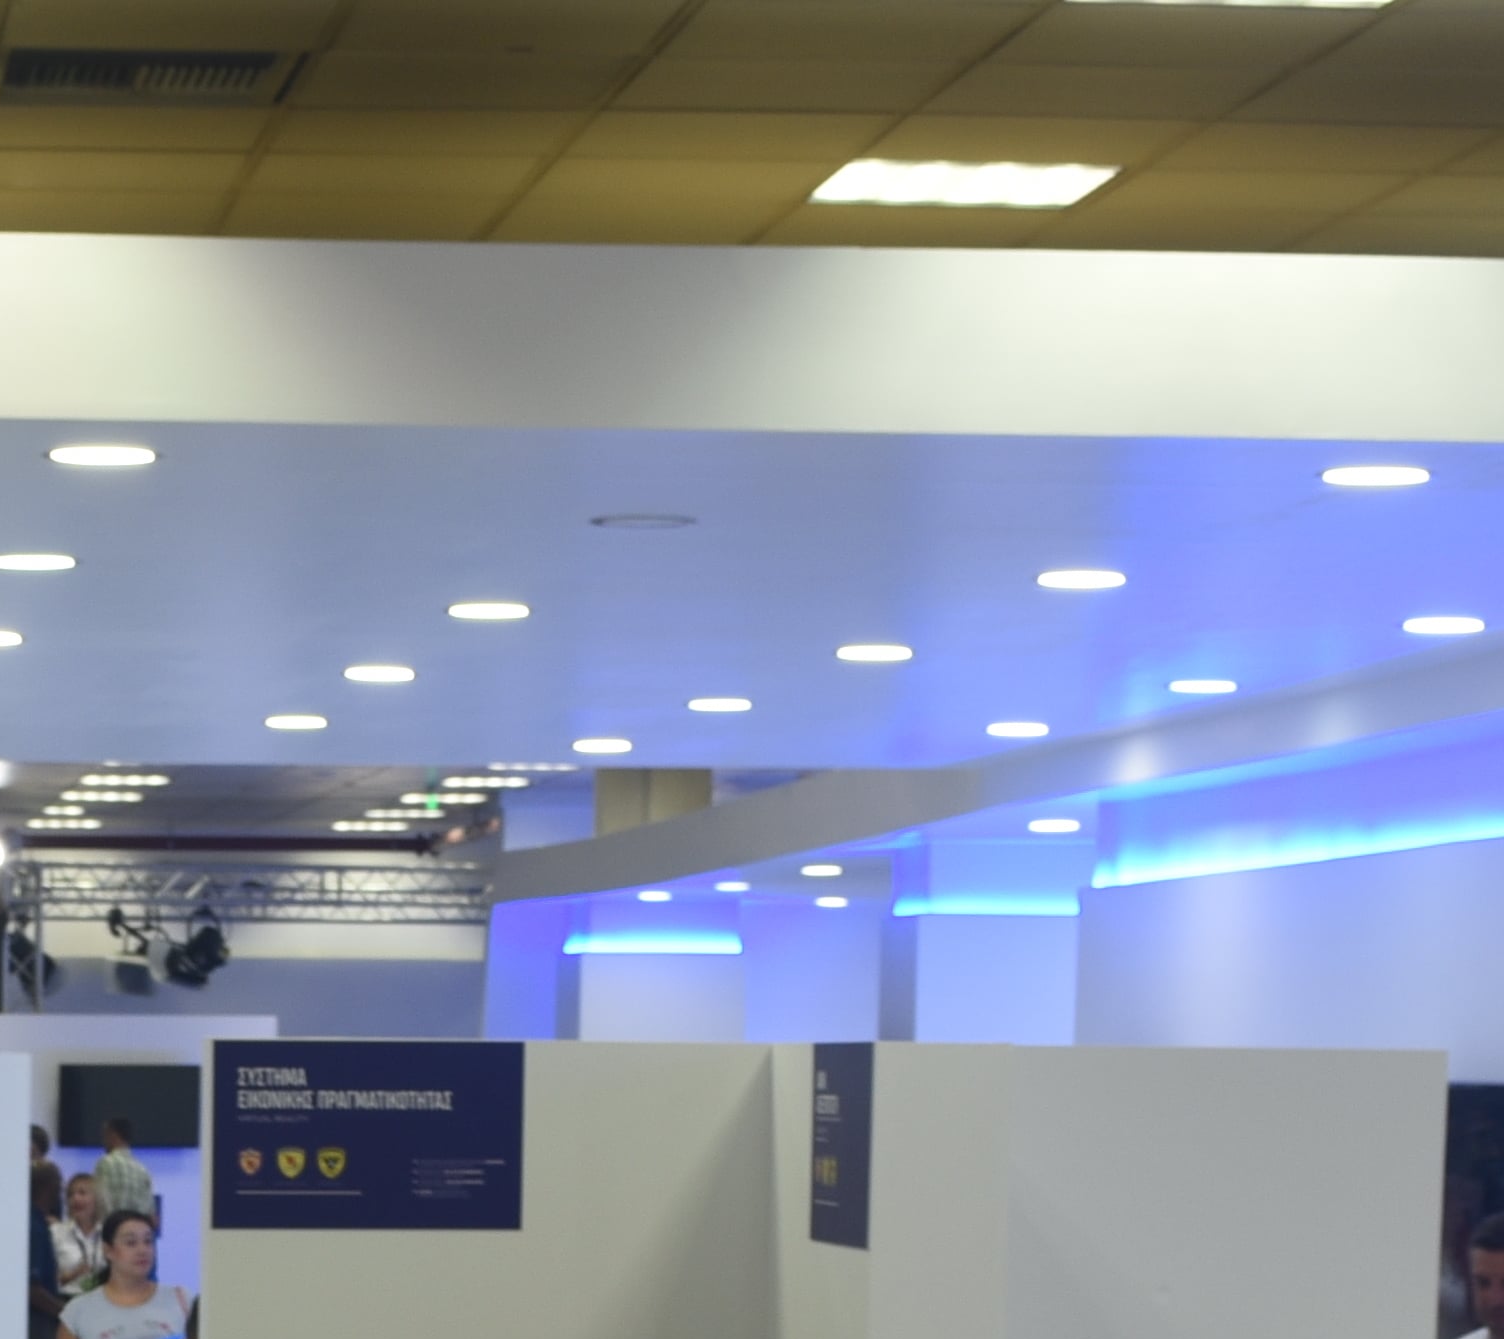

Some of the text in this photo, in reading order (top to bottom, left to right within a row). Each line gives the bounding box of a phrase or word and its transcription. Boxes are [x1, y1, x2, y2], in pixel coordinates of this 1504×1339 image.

[237, 1067, 307, 1087] ΣΥΣΤΗΜΑ
[237, 1090, 452, 1111] ΕΙΚΟΝΙΚΗΣ ΠΡΑΓΜΑΤΙΚΟΤΗΤΑΣ
